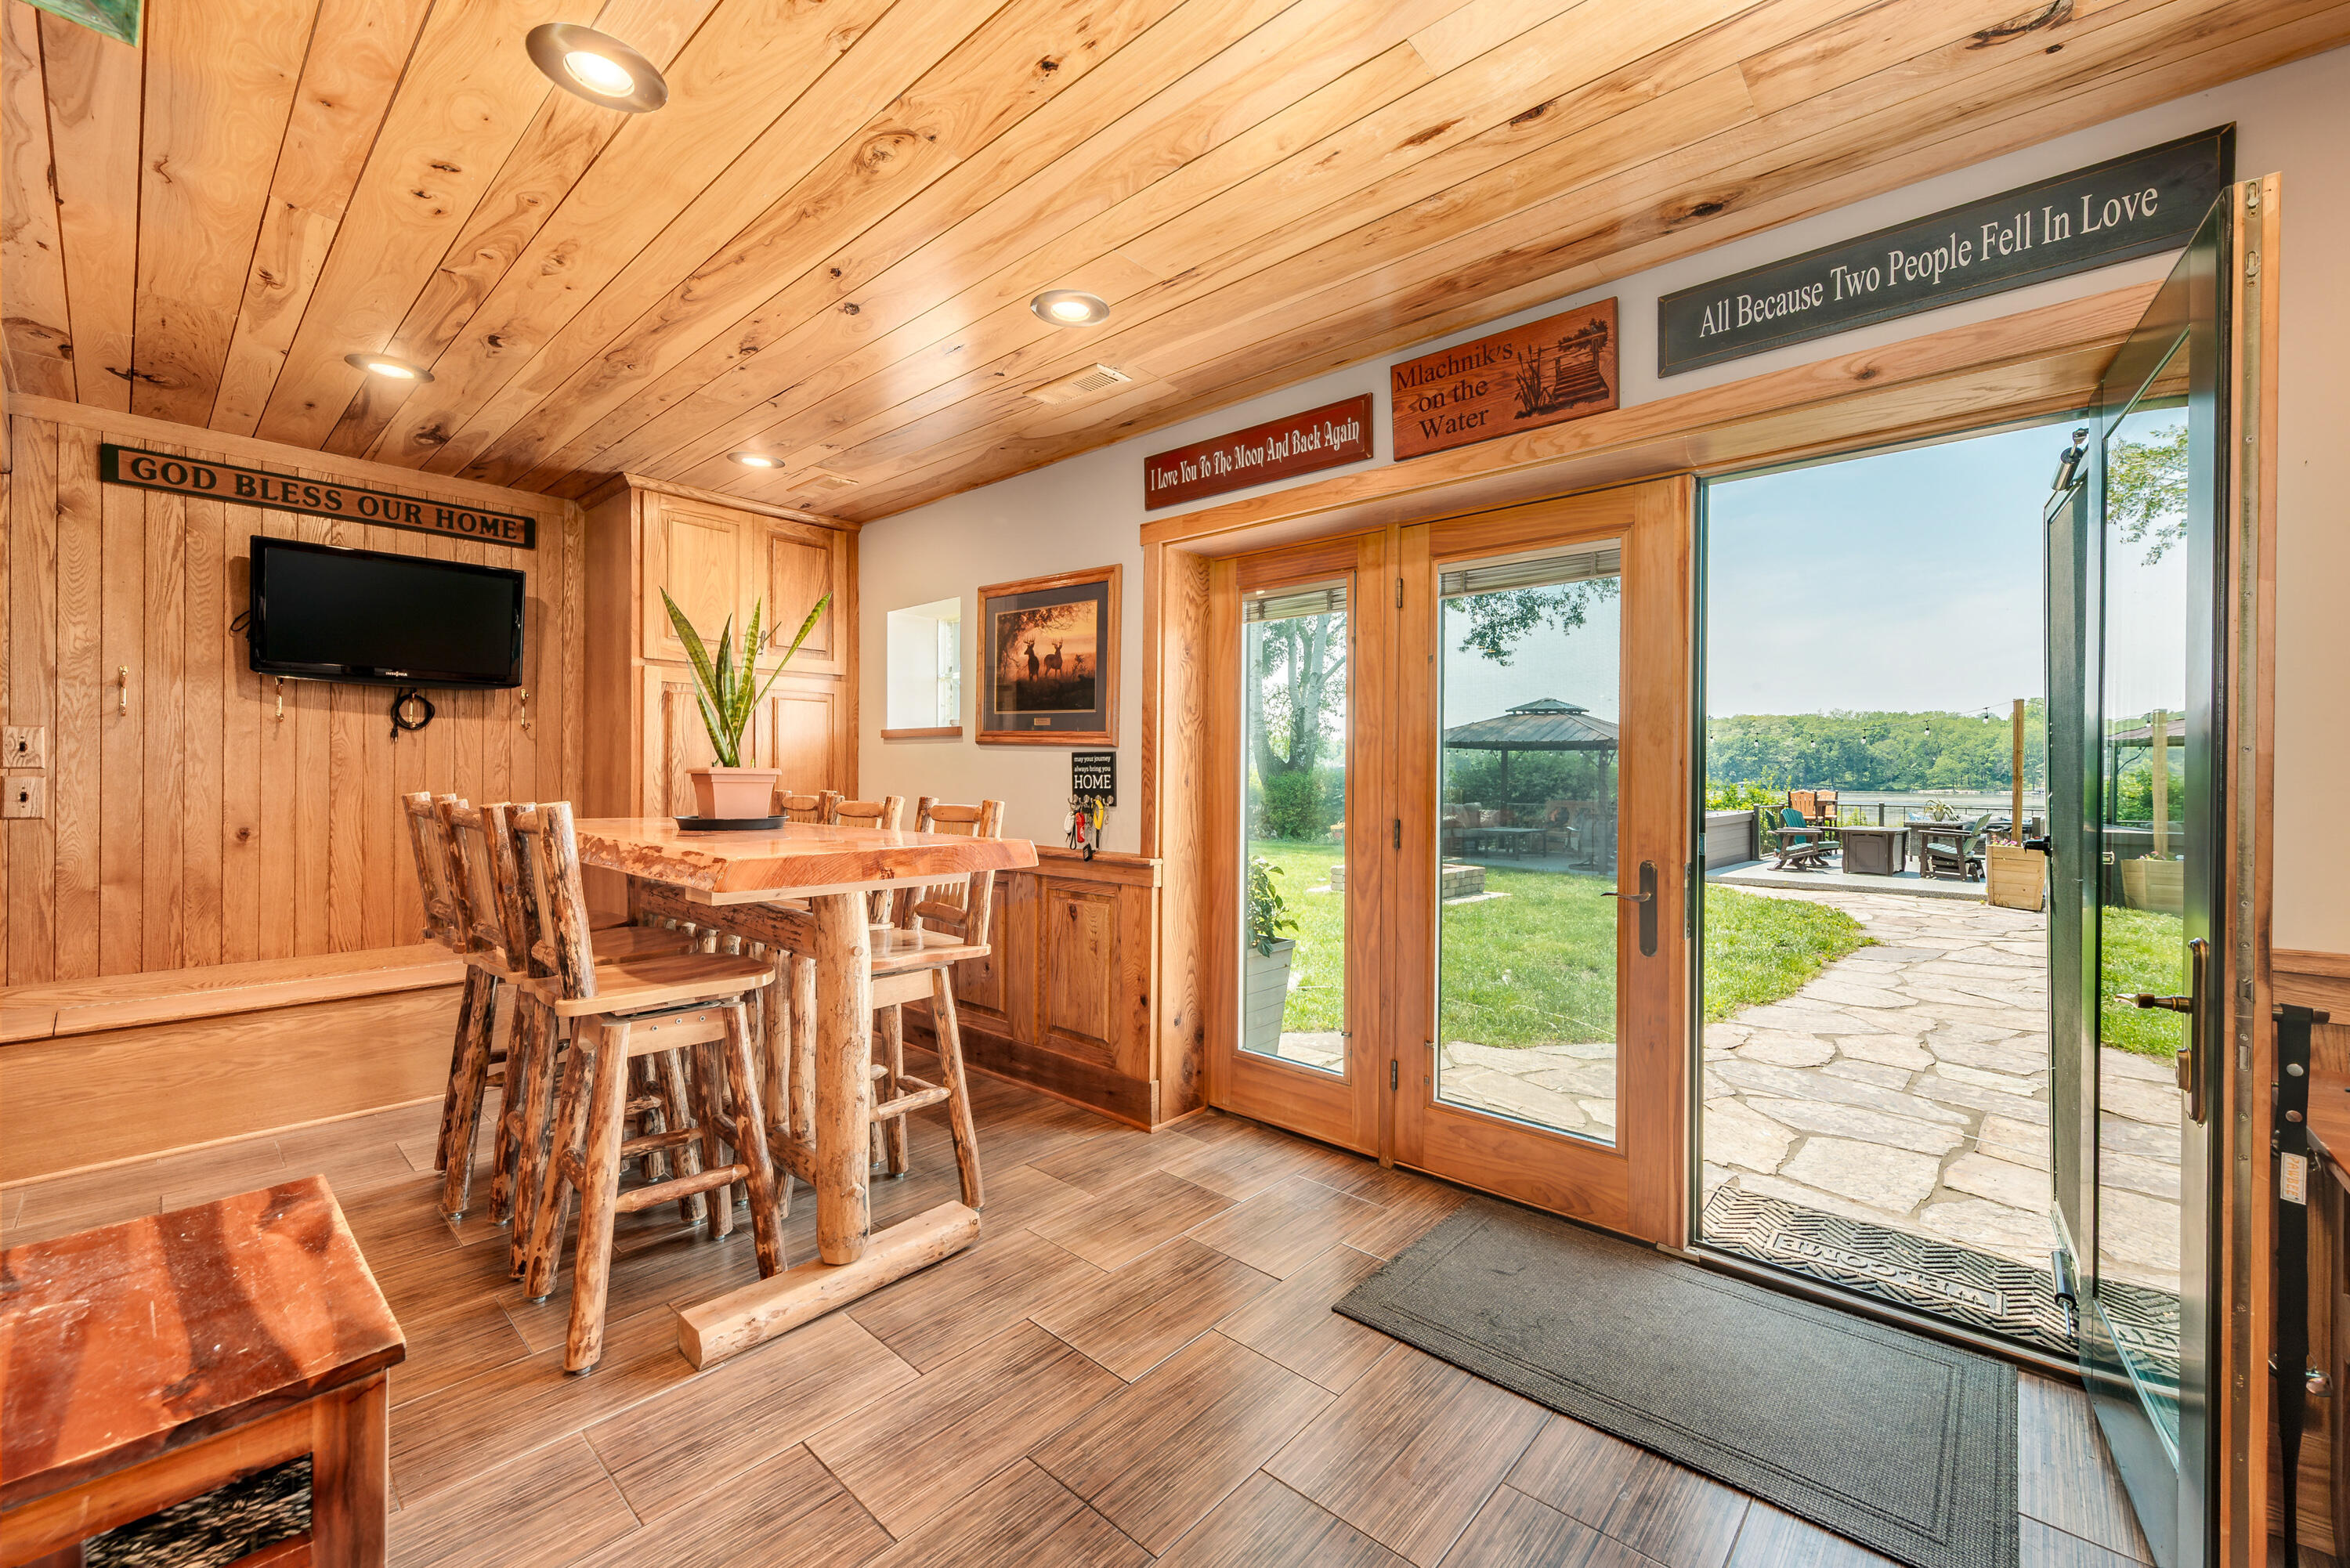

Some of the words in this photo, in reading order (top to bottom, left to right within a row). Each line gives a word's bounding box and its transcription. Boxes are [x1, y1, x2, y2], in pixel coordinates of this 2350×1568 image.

[1699, 298, 1730, 338] All
[1737, 281, 1824, 328] Because
[1830, 266, 1880, 302] Two
[1887, 232, 1972, 287] People
[1979, 210, 2033, 262] Fell
[2041, 205, 2071, 245] In
[2080, 187, 2158, 235] Love
[1396, 342, 1513, 392] Mlachnik's
[1419, 392, 1447, 413] on
[1453, 379, 1489, 403] the
[1151, 468, 1155, 491] I
[1158, 468, 1178, 490] Love
[1180, 461, 1198, 483] You
[1199, 455, 1211, 479] To
[1213, 450, 1231, 477] The
[1235, 444, 1264, 468] Moon
[1266, 432, 1289, 463] And
[1292, 425, 1321, 455] Back
[1324, 417, 1360, 451] Again
[1419, 409, 1490, 440] Water
[131, 457, 217, 490] GOD
[235, 473, 342, 511] BLESS
[357, 495, 423, 525] OUR
[436, 508, 518, 540] HOME
[1074, 775, 1112, 789] HOME
[1778, 1237, 1992, 1309] WELCOME
